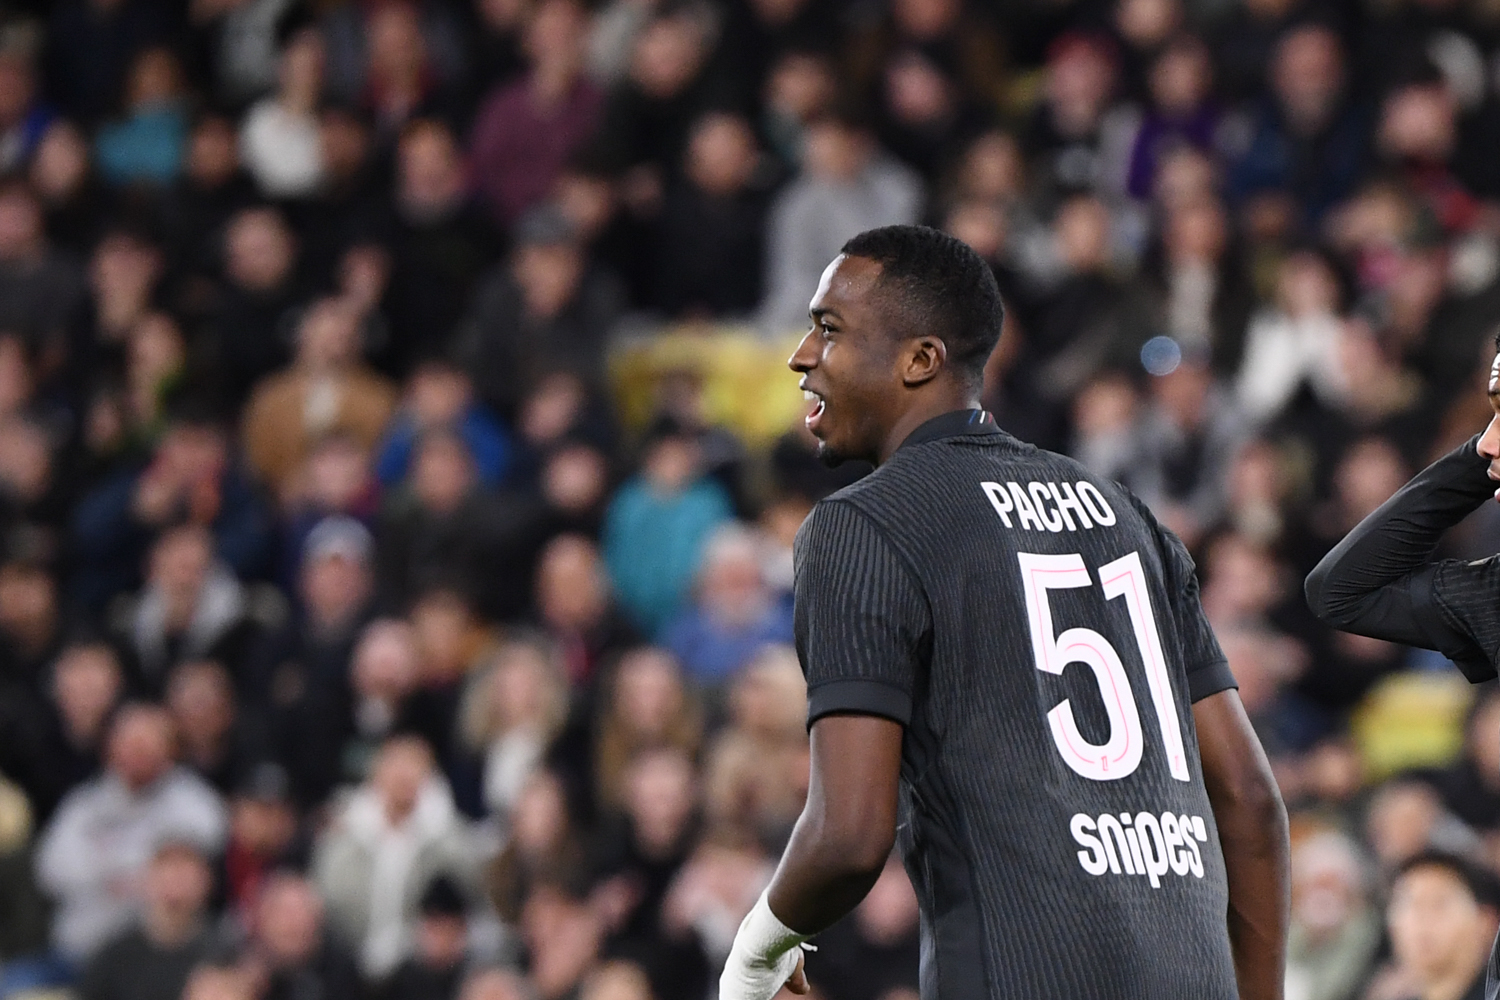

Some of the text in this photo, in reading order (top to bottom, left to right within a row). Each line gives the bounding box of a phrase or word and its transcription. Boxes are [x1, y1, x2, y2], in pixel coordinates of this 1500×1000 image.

[980, 480, 1118, 533] PACHO
[1016, 550, 1191, 783] 51
[1070, 811, 1207, 889] snipes
